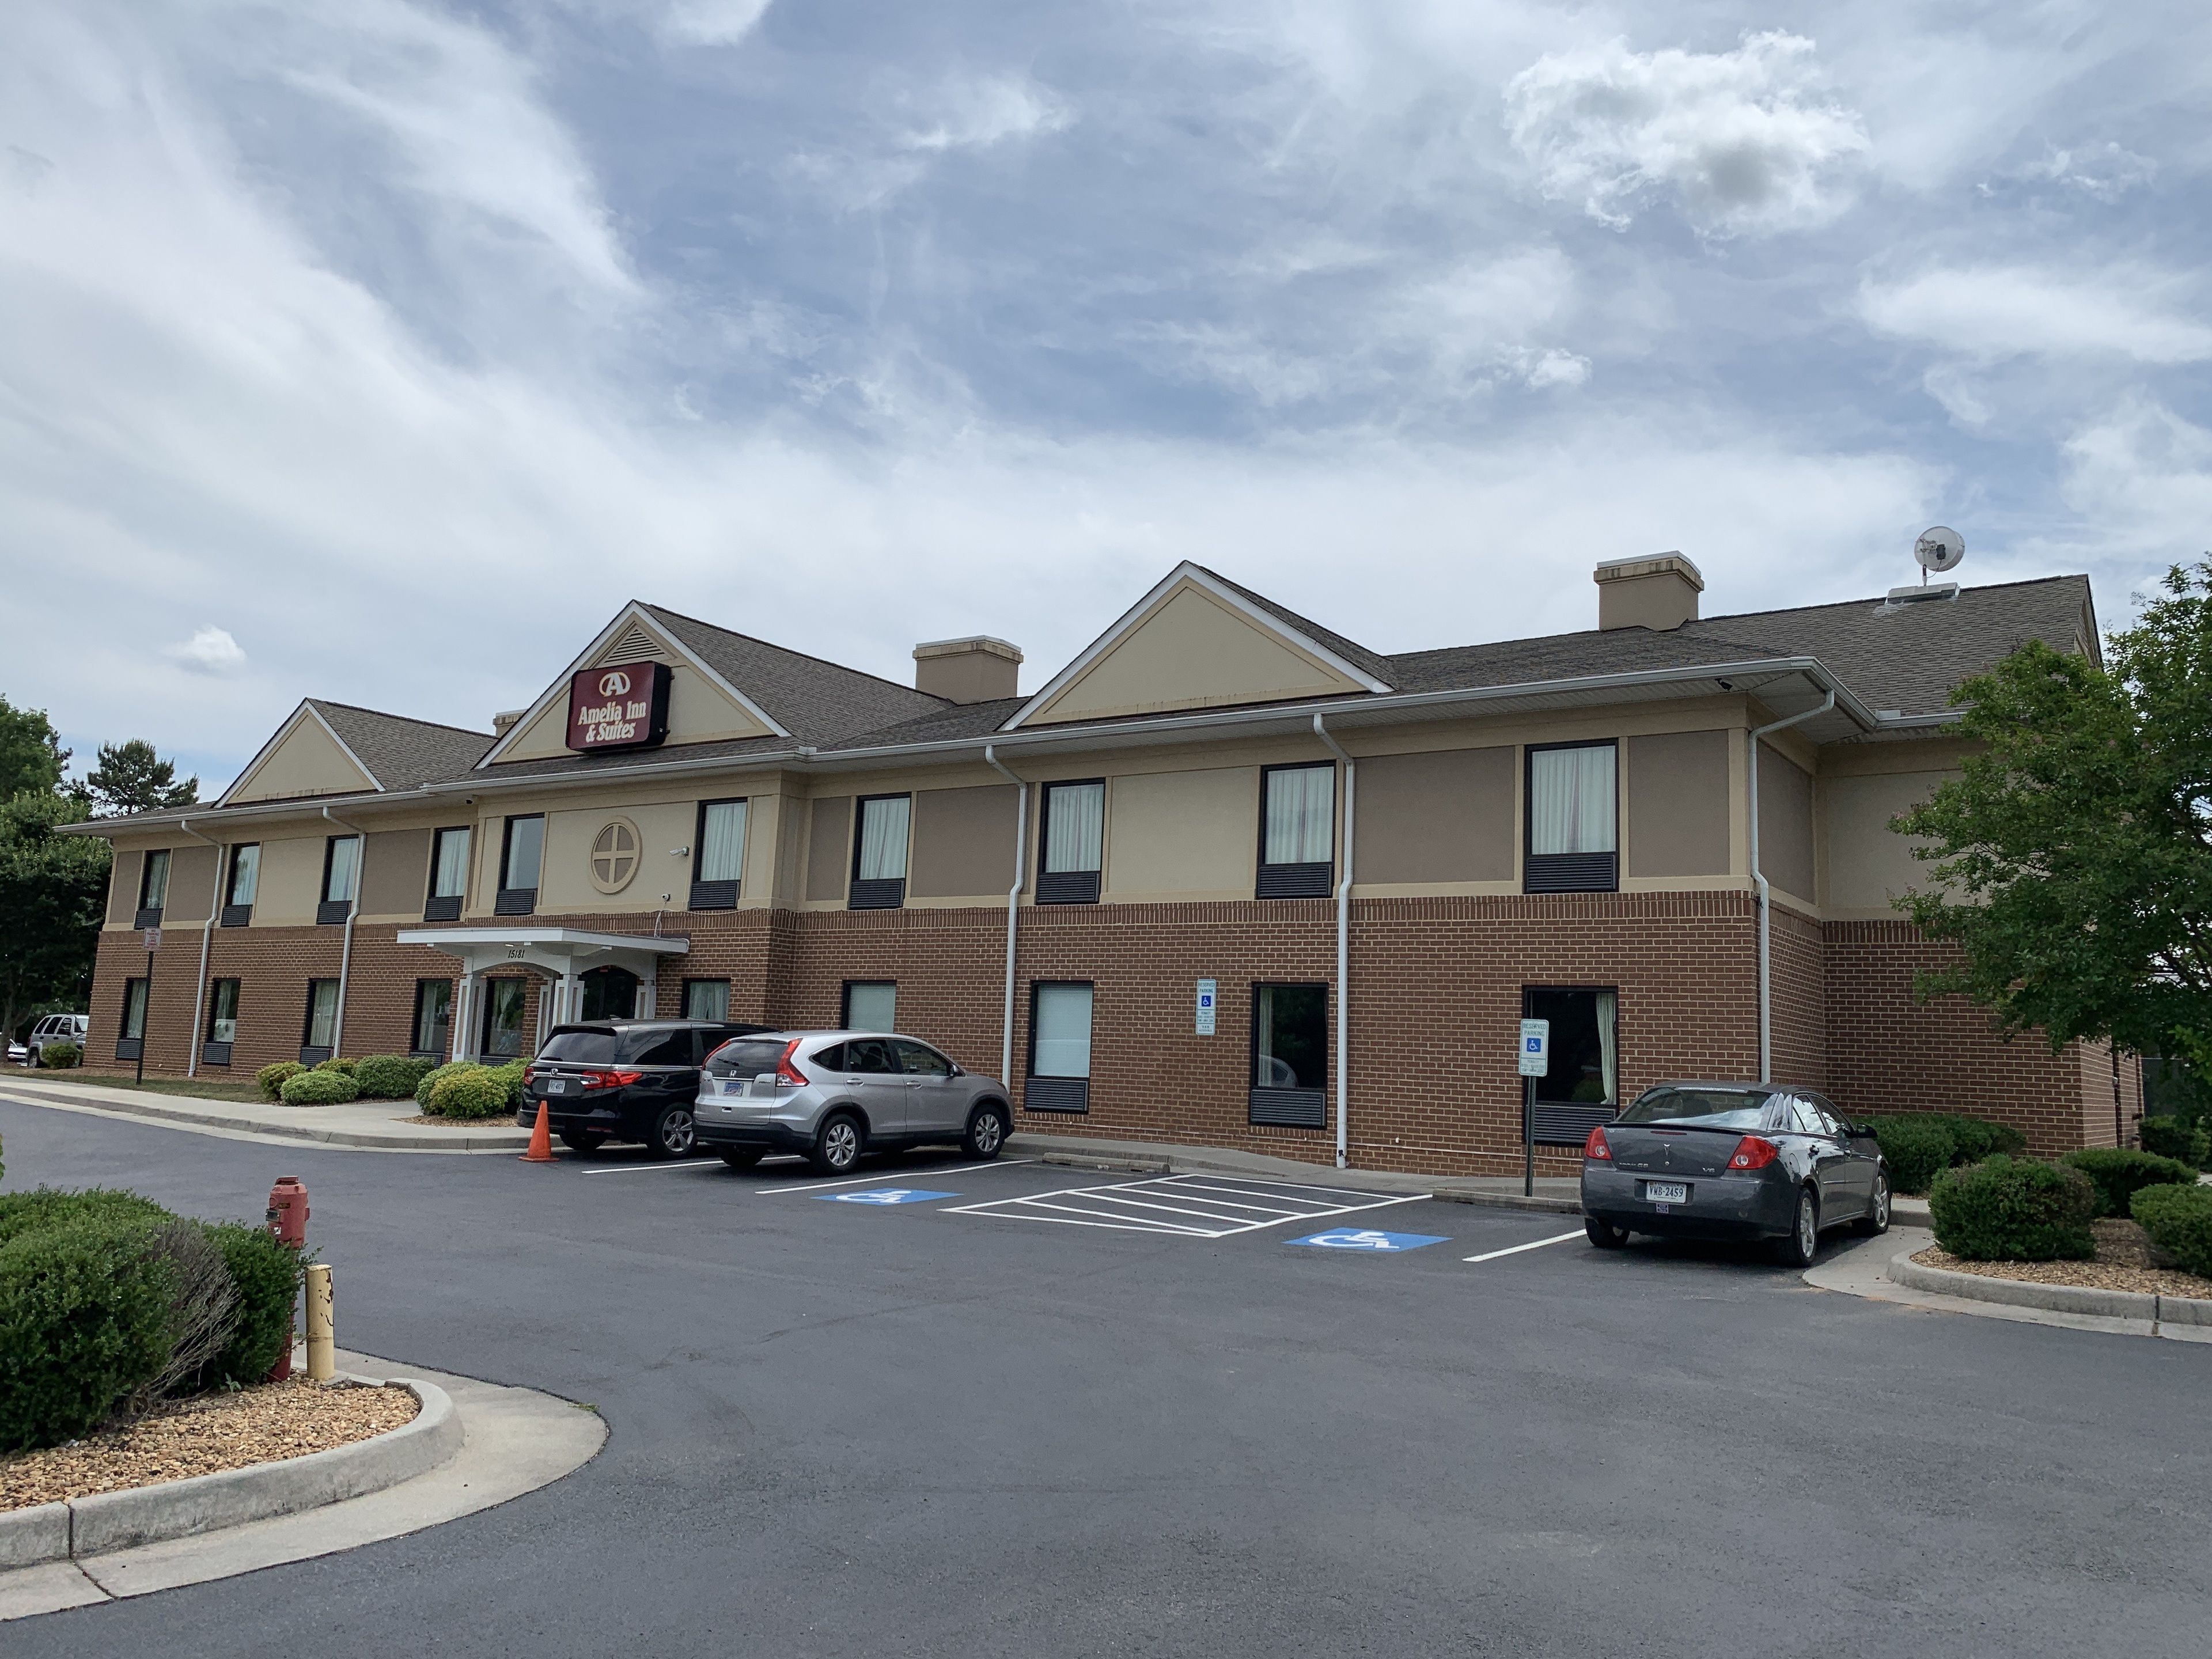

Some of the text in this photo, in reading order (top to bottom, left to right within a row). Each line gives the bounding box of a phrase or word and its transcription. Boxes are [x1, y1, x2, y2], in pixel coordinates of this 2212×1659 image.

[578, 700, 646, 725] Amelia Inn
[585, 720, 637, 743] & Suites
[507, 949, 525, 959] 15181
[1650, 1186, 1683, 1197] VMB-2459
